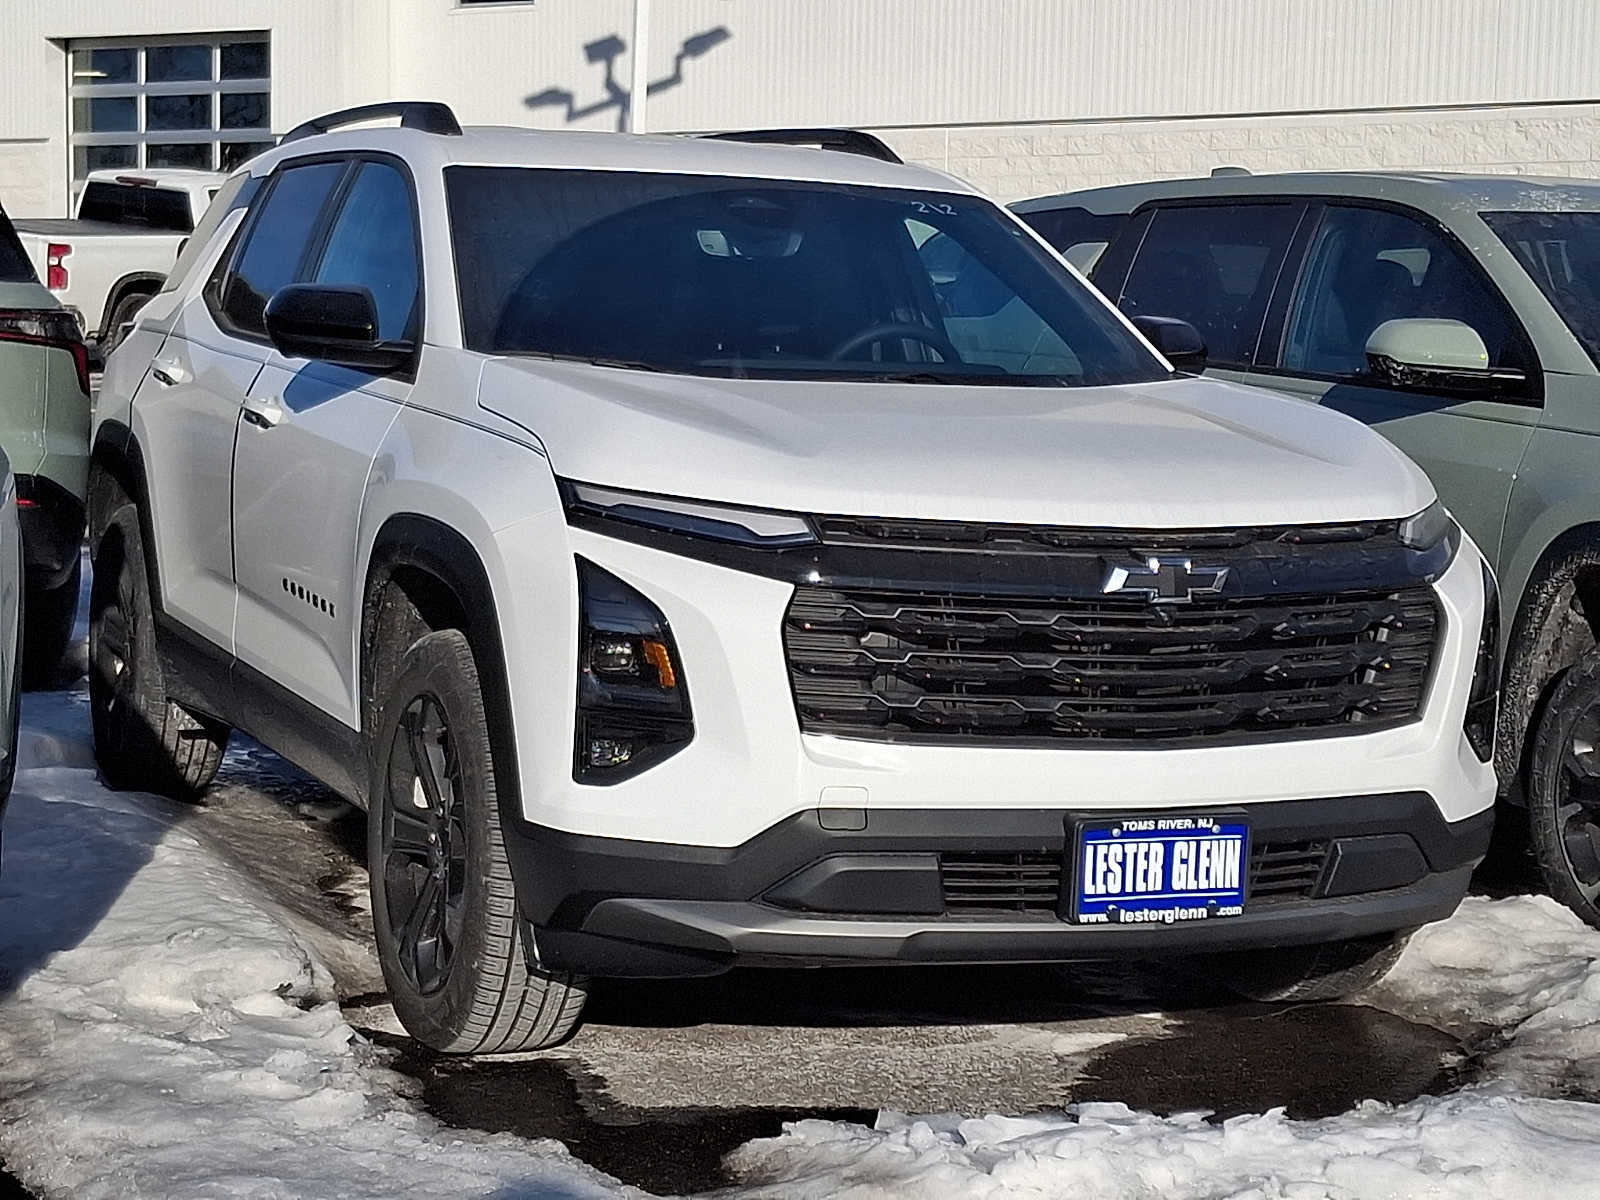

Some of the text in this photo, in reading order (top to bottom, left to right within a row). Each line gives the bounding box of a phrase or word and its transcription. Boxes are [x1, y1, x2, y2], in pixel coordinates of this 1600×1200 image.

[1122, 820, 1155, 831] TOMS
[1197, 818, 1213, 829] NJ
[1084, 839, 1241, 895] LESTER GLENN
[1120, 907, 1207, 924] lesterglenn
